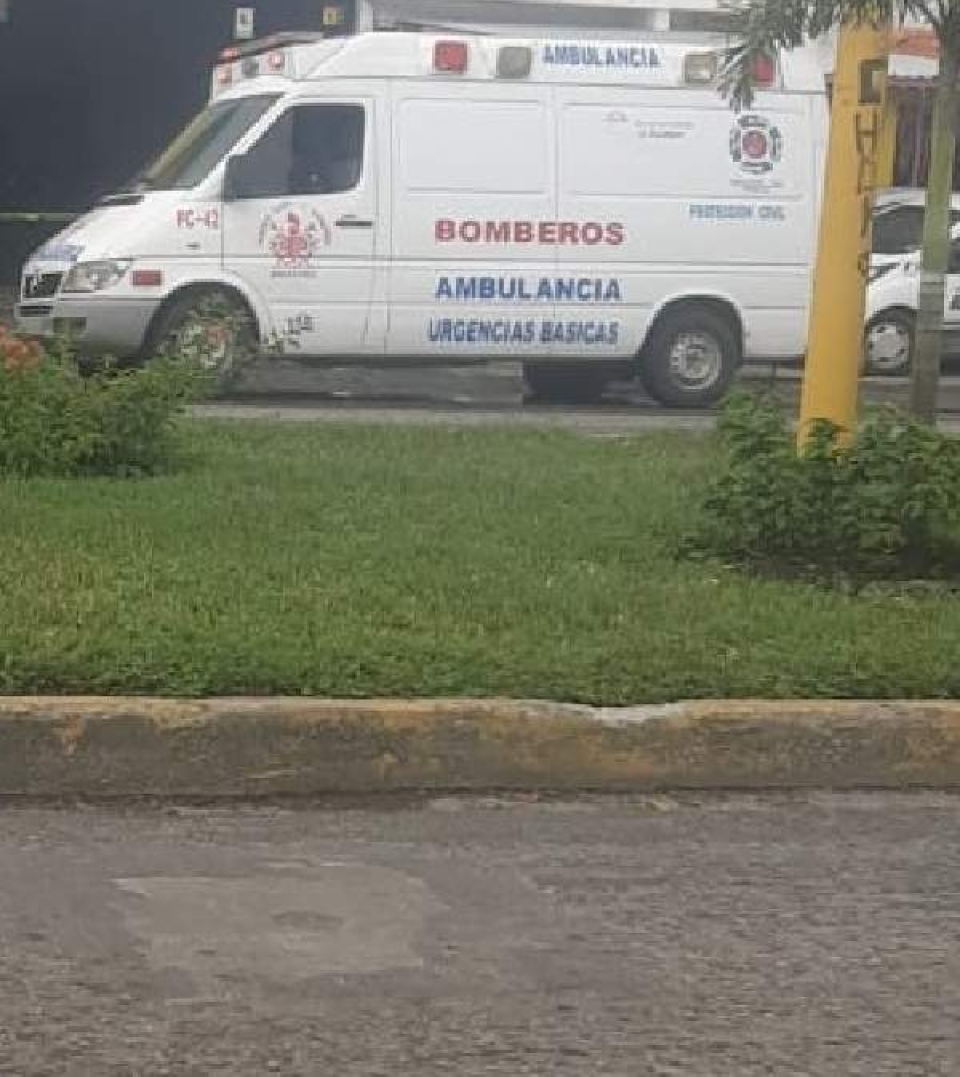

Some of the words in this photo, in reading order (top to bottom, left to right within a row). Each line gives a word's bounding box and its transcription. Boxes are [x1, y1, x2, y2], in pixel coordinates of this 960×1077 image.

[542, 45, 660, 68] AMBULANCIA
[435, 220, 624, 245] BOMBEROS
[435, 276, 621, 302] AMBULANCIA
[428, 318, 535, 343] URGENCIAS
[541, 321, 620, 345] BASICAS
